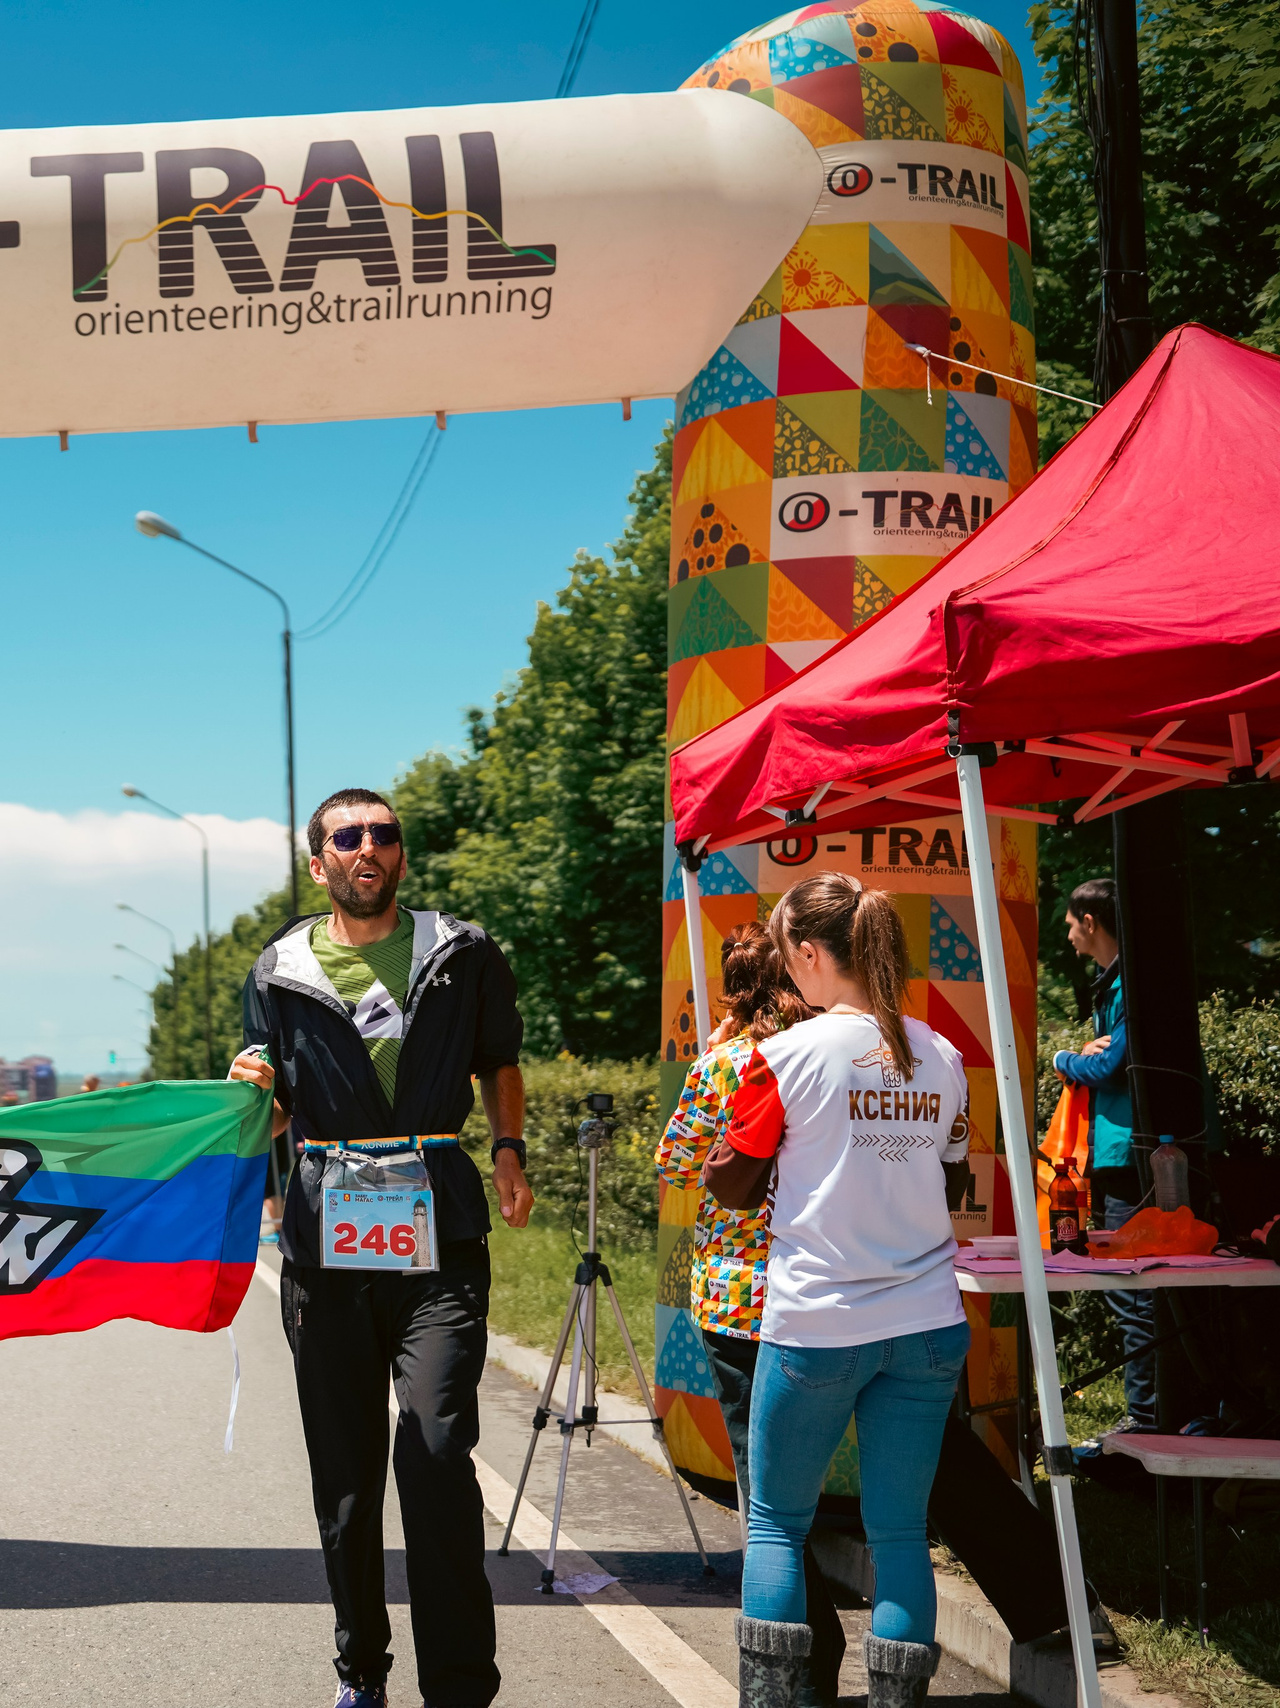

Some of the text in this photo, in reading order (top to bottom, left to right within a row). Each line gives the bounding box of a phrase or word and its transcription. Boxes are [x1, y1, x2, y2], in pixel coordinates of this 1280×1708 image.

[908, 194, 1005, 219] orienteering&trailrunning
[74, 283, 554, 338] orienteering&trailrunning
[872, 527, 970, 540] orienteering&trail
[860, 865, 971, 878] orienteering&trailru
[848, 1089, 941, 1124] КСЕНИЯ
[333, 1222, 416, 1257] 246
